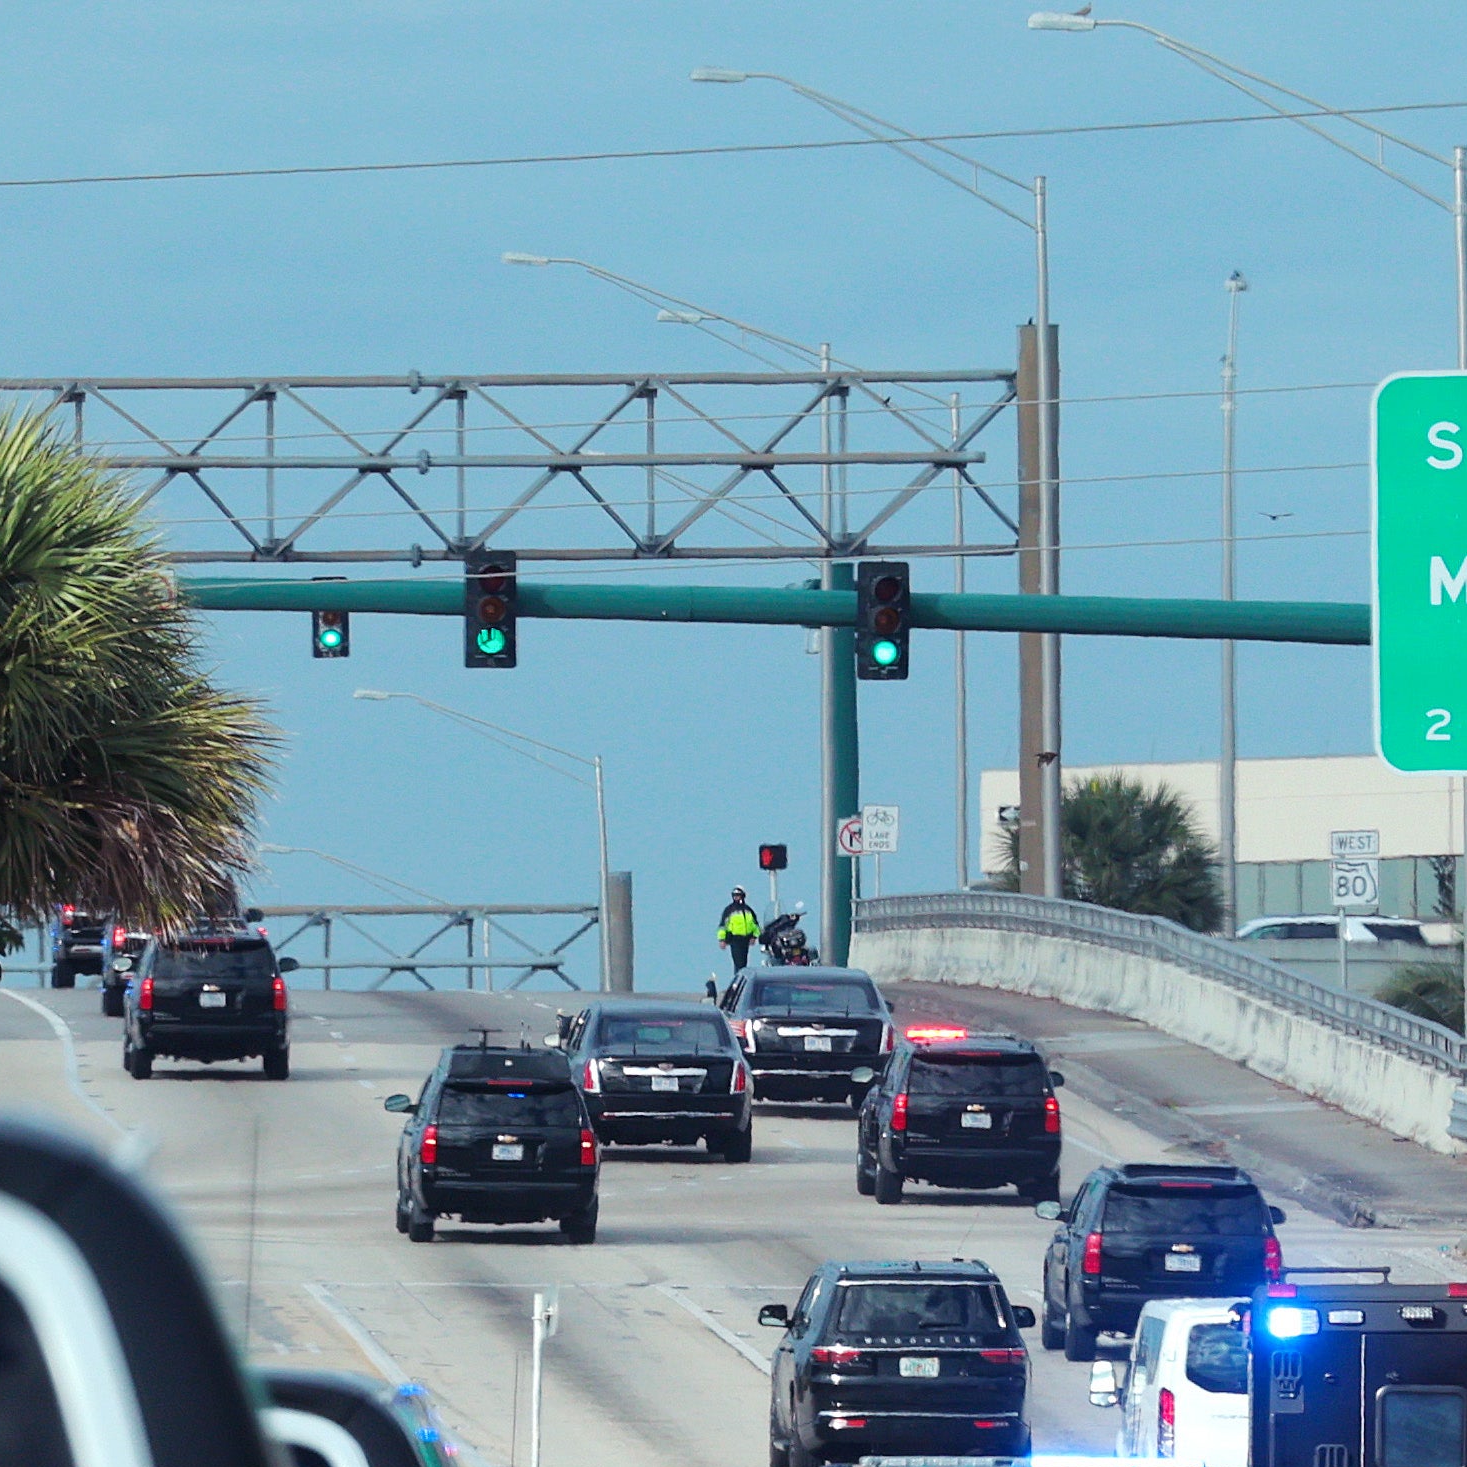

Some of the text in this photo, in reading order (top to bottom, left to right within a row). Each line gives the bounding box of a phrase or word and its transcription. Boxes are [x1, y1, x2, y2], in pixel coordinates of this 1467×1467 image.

[1425, 708, 1451, 742] 2
[1338, 836, 1371, 850] WEST
[1337, 876, 1367, 897] 80
